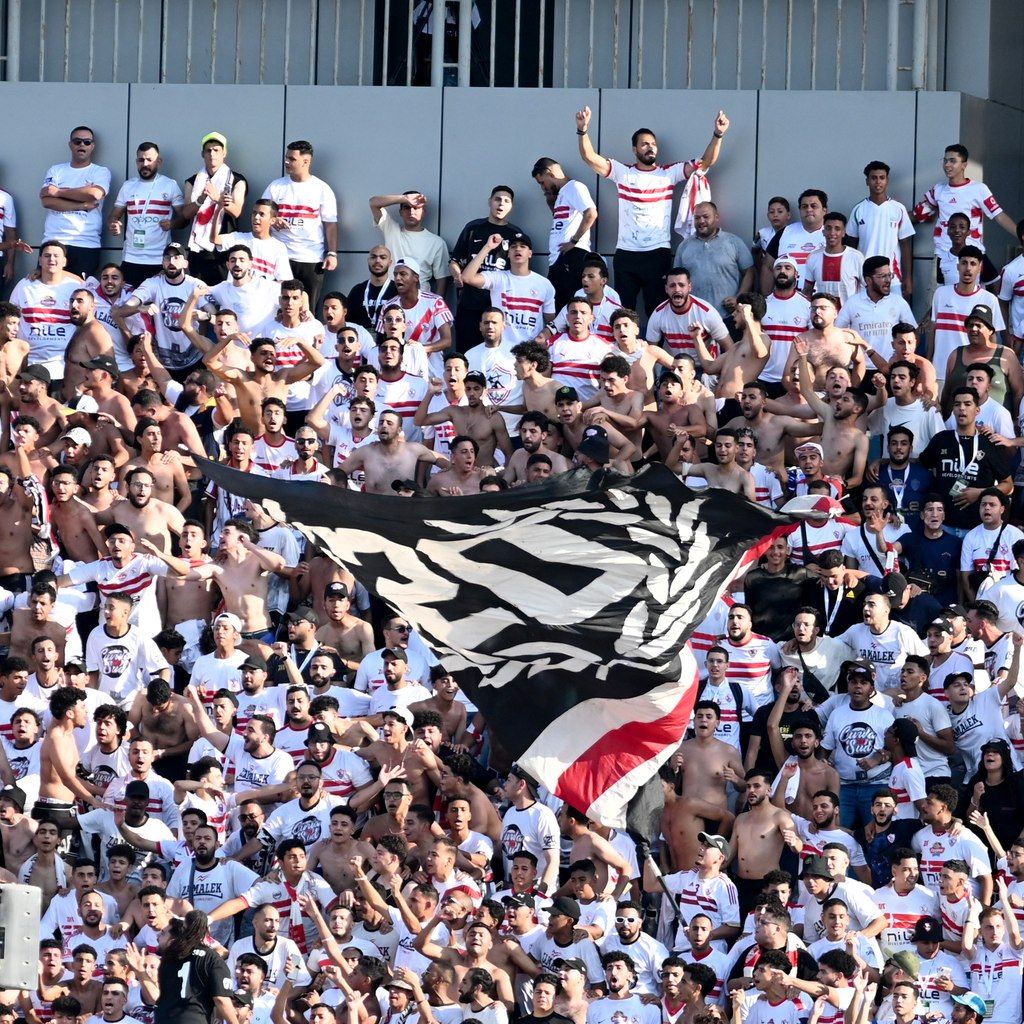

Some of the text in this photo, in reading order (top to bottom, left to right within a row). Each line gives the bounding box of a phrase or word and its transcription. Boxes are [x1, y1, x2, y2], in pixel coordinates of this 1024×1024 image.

[839, 727, 876, 744] Curva
[845, 740, 874, 755] Sud
[176, 961, 190, 999] 1
